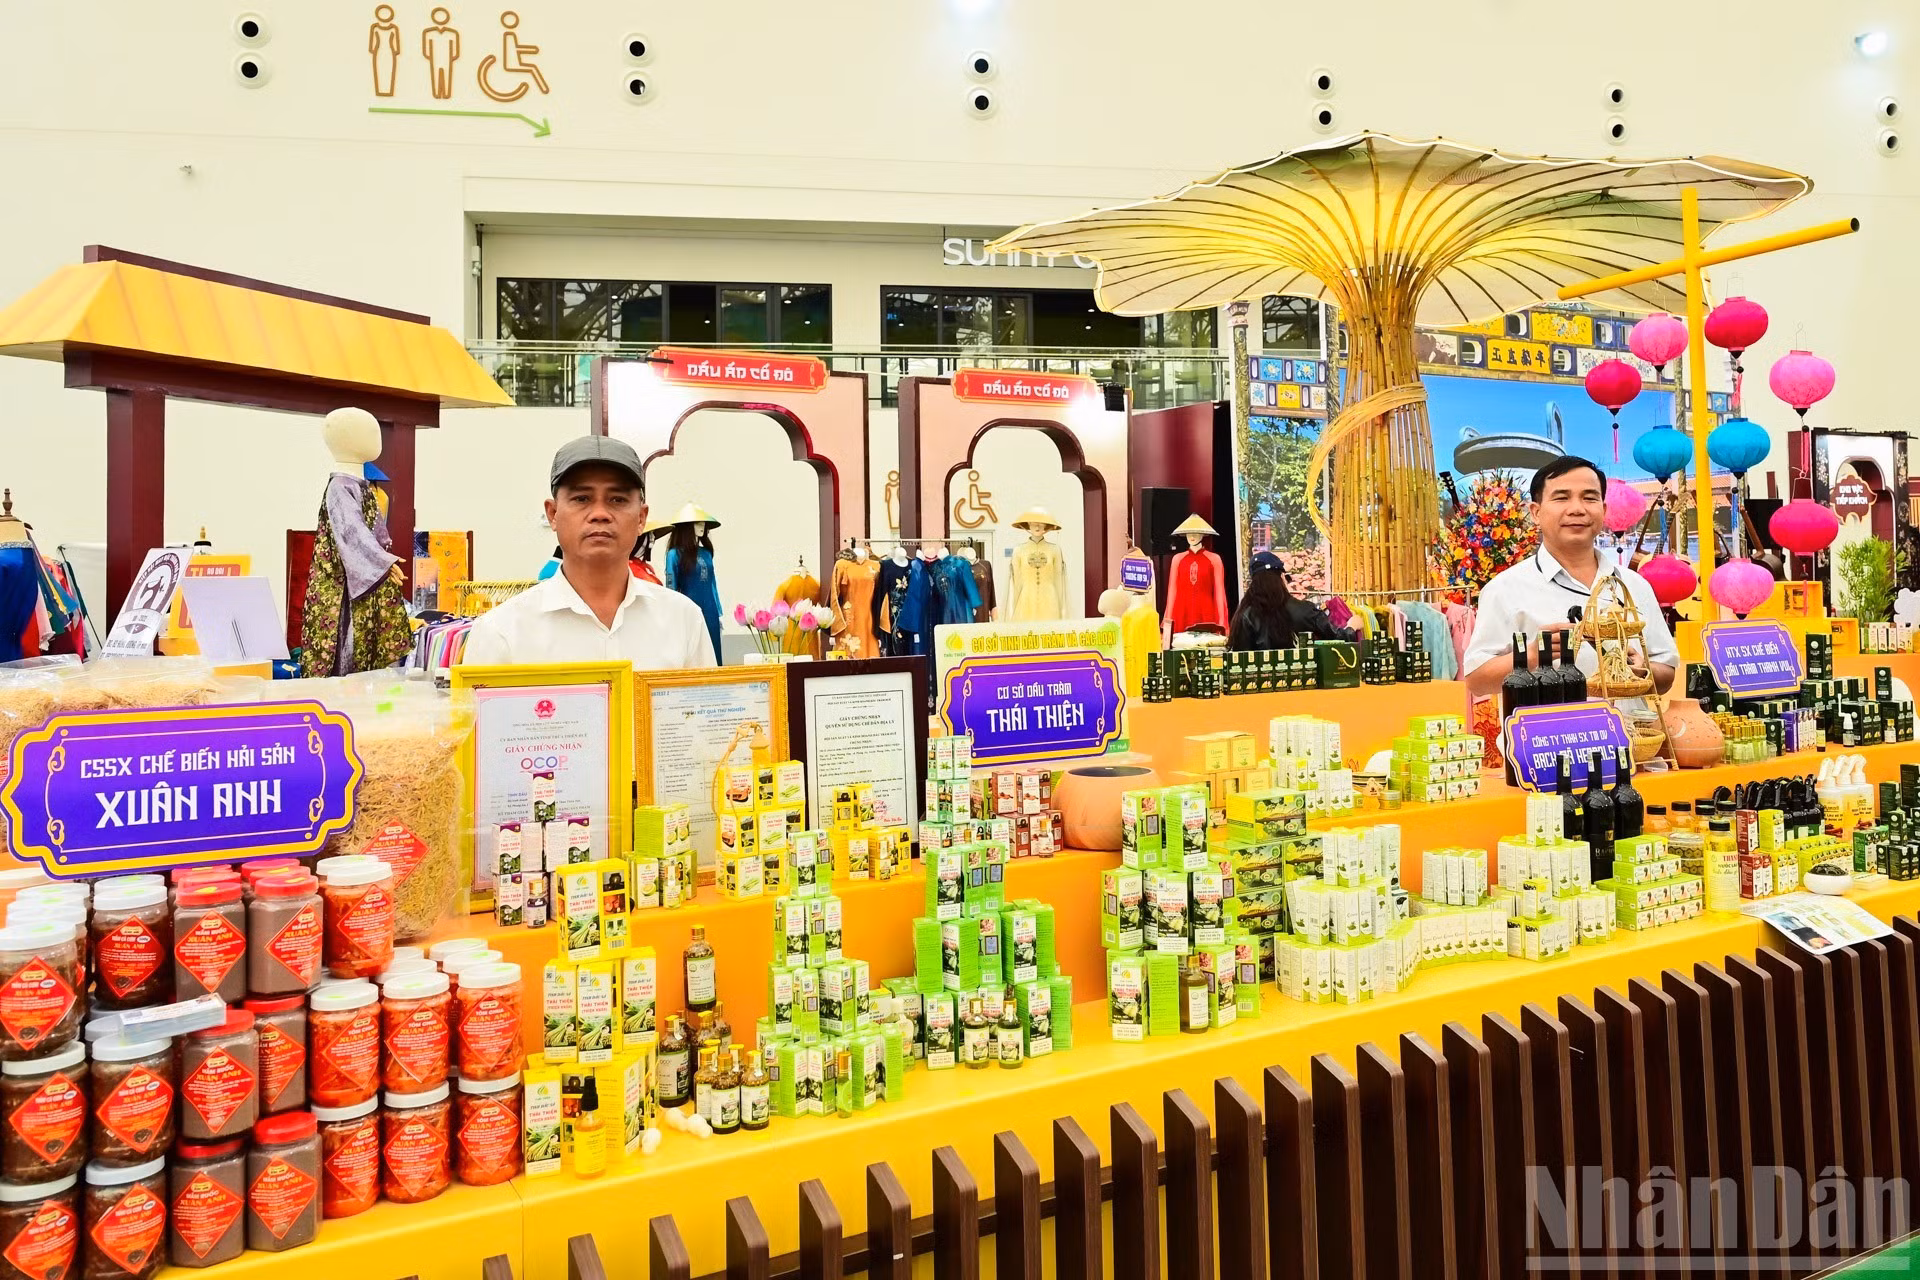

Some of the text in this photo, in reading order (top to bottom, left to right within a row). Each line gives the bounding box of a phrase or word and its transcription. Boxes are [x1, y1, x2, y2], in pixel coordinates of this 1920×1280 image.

[688, 360, 793, 382] DẤU ẤN CỐ ĐÔ
[983, 380, 1011, 395] DẤU
[1033, 383, 1050, 397] CỐ
[1000, 636, 1020, 651] TINH
[1022, 631, 1039, 650] DẦU
[1725, 646, 1741, 658] HTX
[1740, 646, 1752, 657] SX
[997, 682, 1072, 700] CƠ SỞ DẦU TRÀM
[986, 700, 1084, 733] THÁI THIỆN
[505, 743, 582, 753] GIẤY CHỨNG NHẬN
[1532, 736, 1549, 748] CÔNG
[1550, 735, 1559, 745] TY
[1561, 733, 1579, 744] TNHH
[1578, 732, 1589, 743] SX
[80, 743, 295, 779] CSSX CHẾ BIẾN HẢI SẢN
[521, 756, 568, 770] OCOP
[1533, 752, 1558, 771] BẠCH
[96, 780, 282, 829] XUÂN ANH
